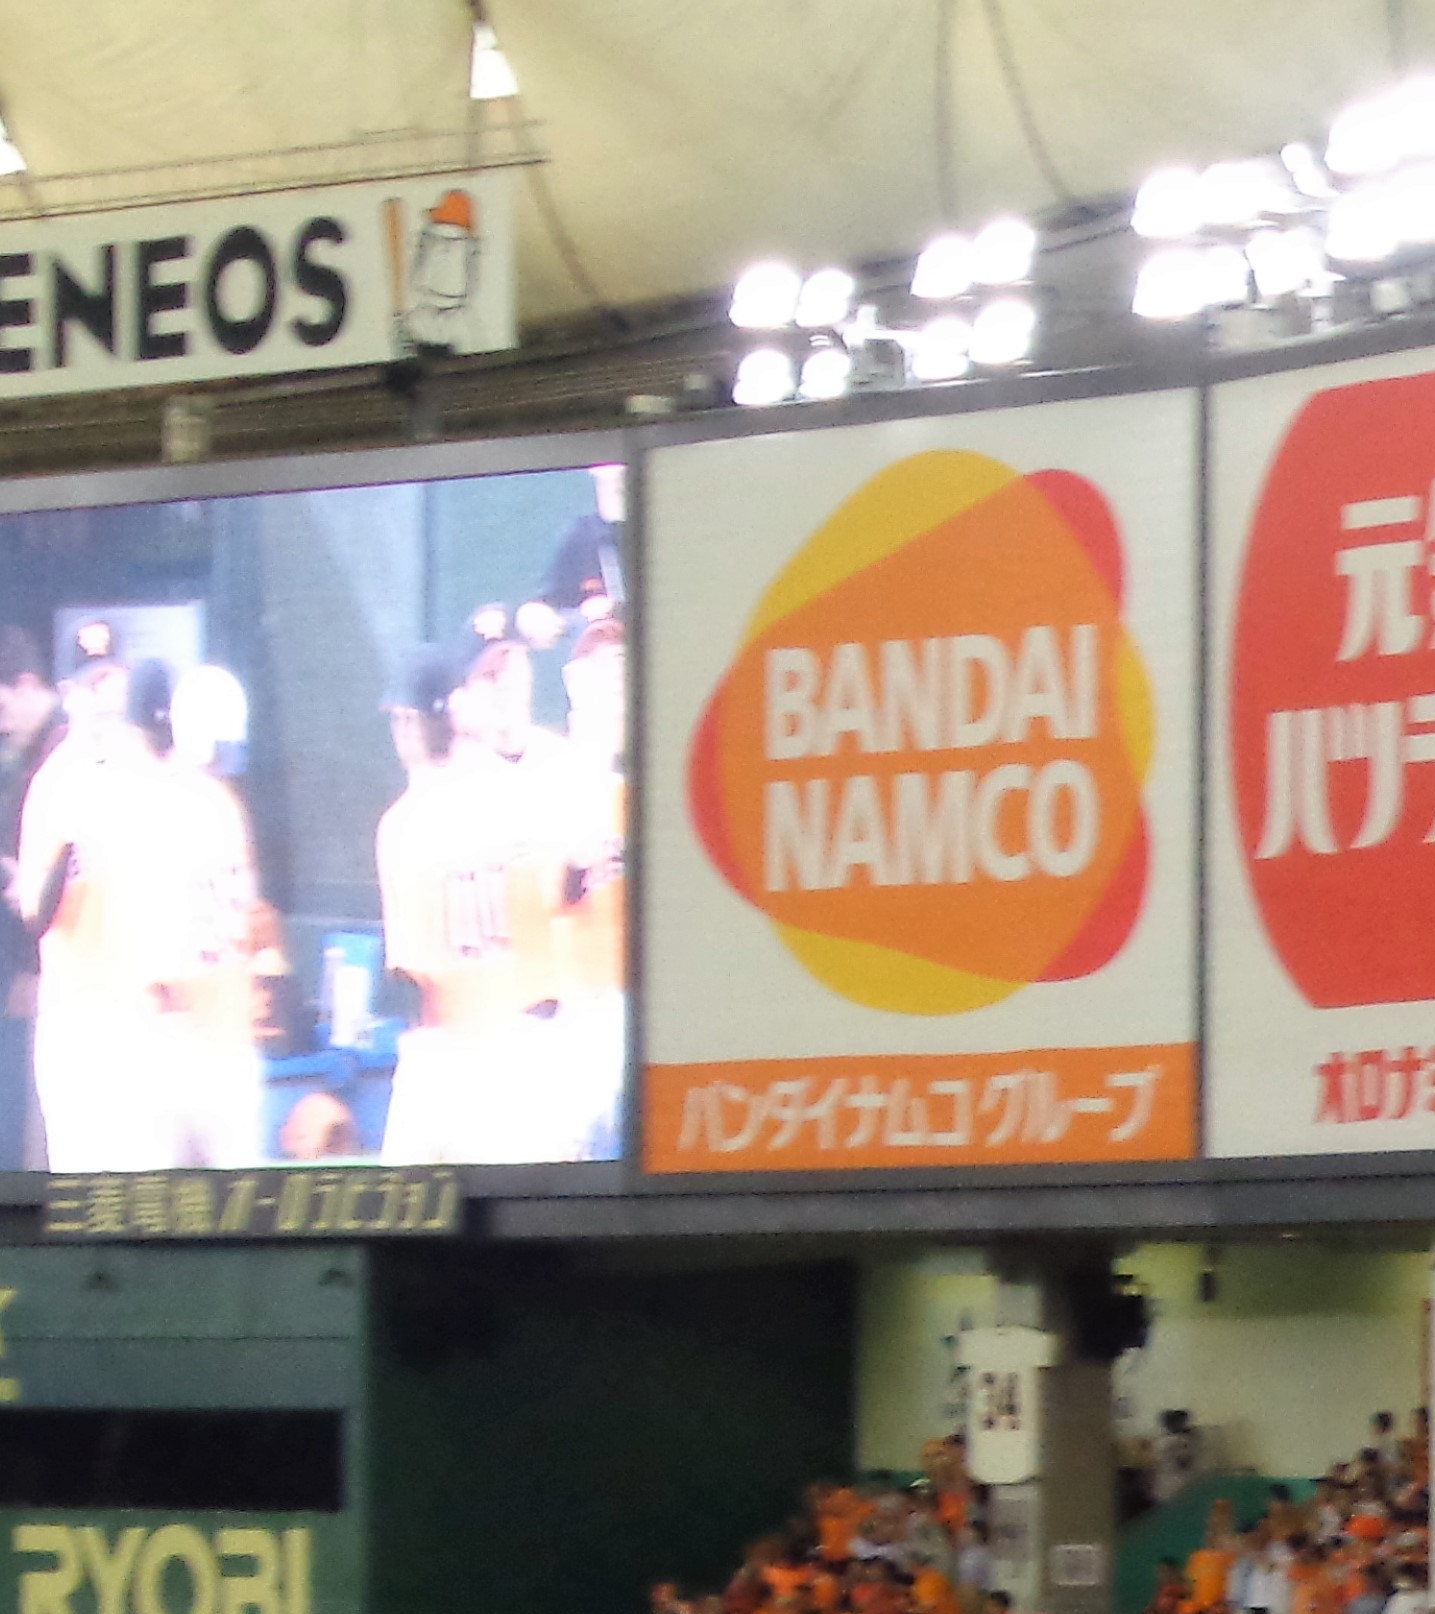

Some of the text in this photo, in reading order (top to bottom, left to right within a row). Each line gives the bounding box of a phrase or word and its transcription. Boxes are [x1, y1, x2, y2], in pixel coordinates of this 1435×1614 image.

[0, 216, 348, 374] ENEOS
[764, 623, 1099, 762] BANDAI
[764, 758, 1097, 893] NAMCO
[677, 1063, 1164, 1154] バンダイナムコグループ
